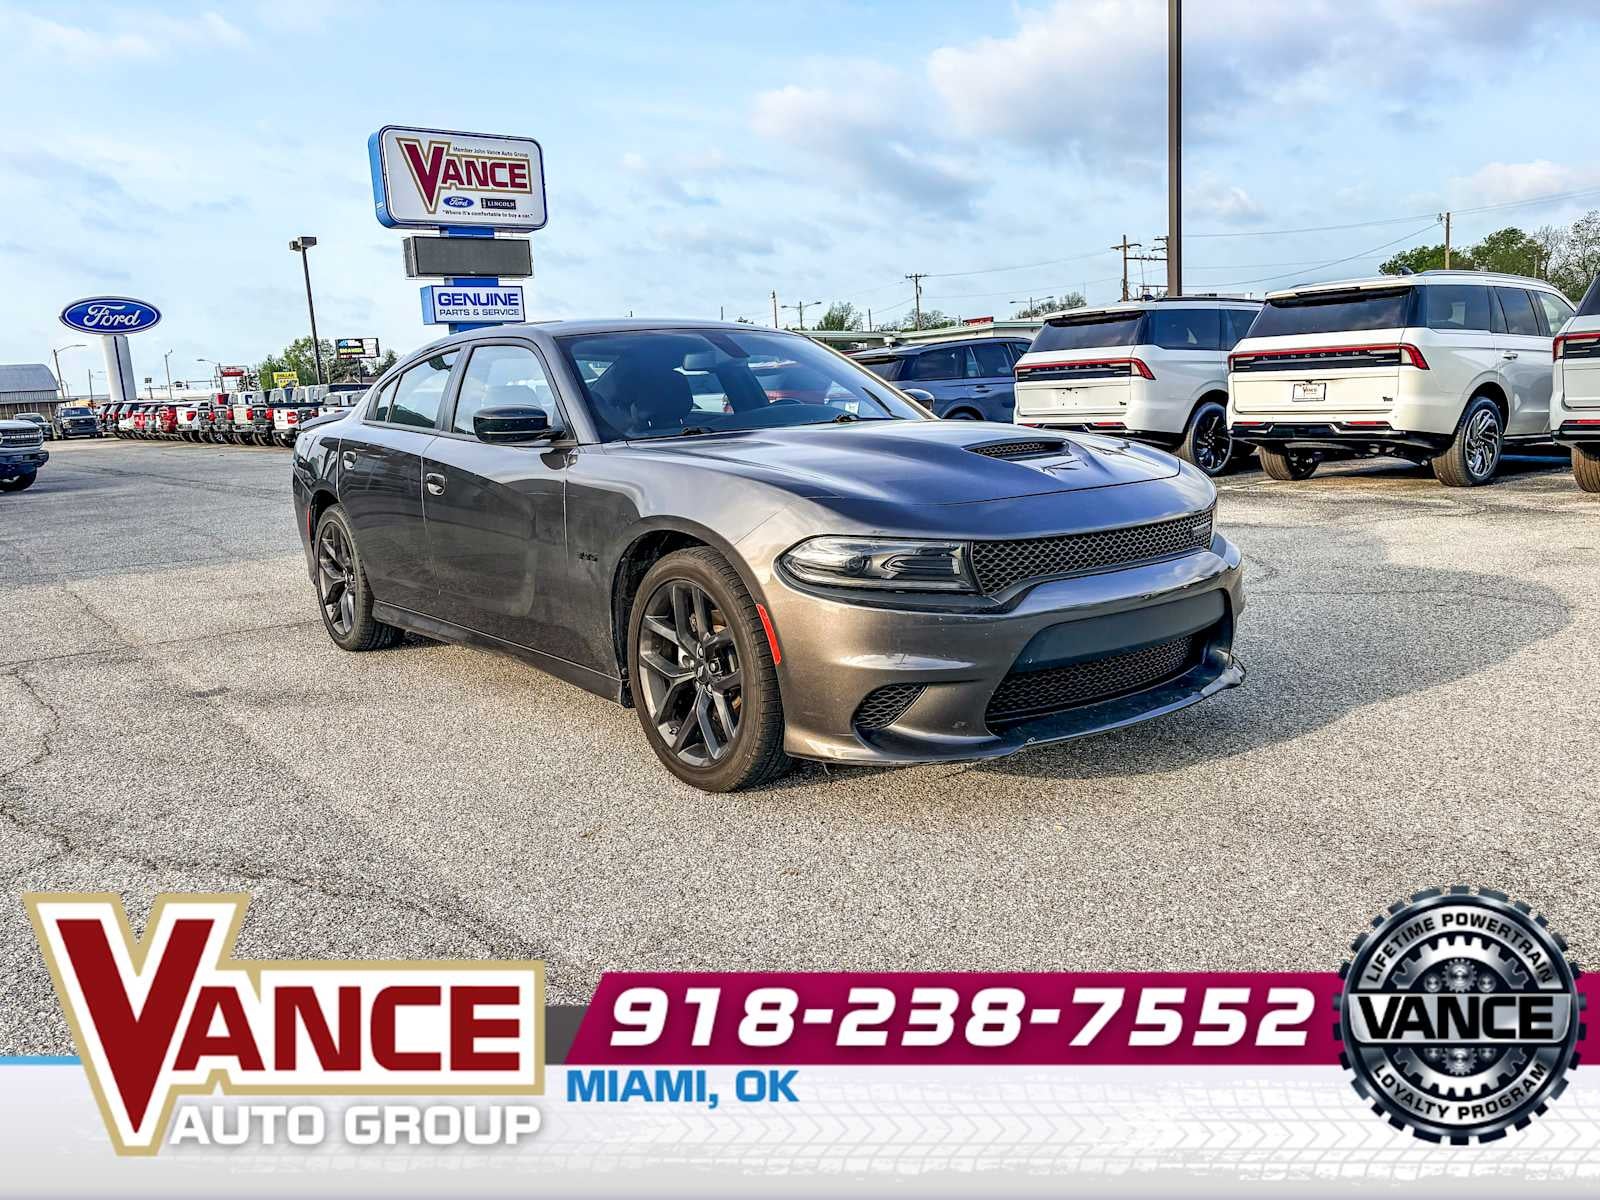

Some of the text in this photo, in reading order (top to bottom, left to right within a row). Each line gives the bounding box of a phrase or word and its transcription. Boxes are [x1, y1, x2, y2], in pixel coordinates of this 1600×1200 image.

[402, 142, 528, 208] VANCE
[448, 197, 469, 207] Ford
[487, 200, 516, 208] LINCOLN
[437, 292, 520, 307] GENUINE
[83, 303, 141, 327] Ford
[439, 308, 520, 316] PARTS & SERVICE
[1263, 350, 1360, 361] LINCOLN
